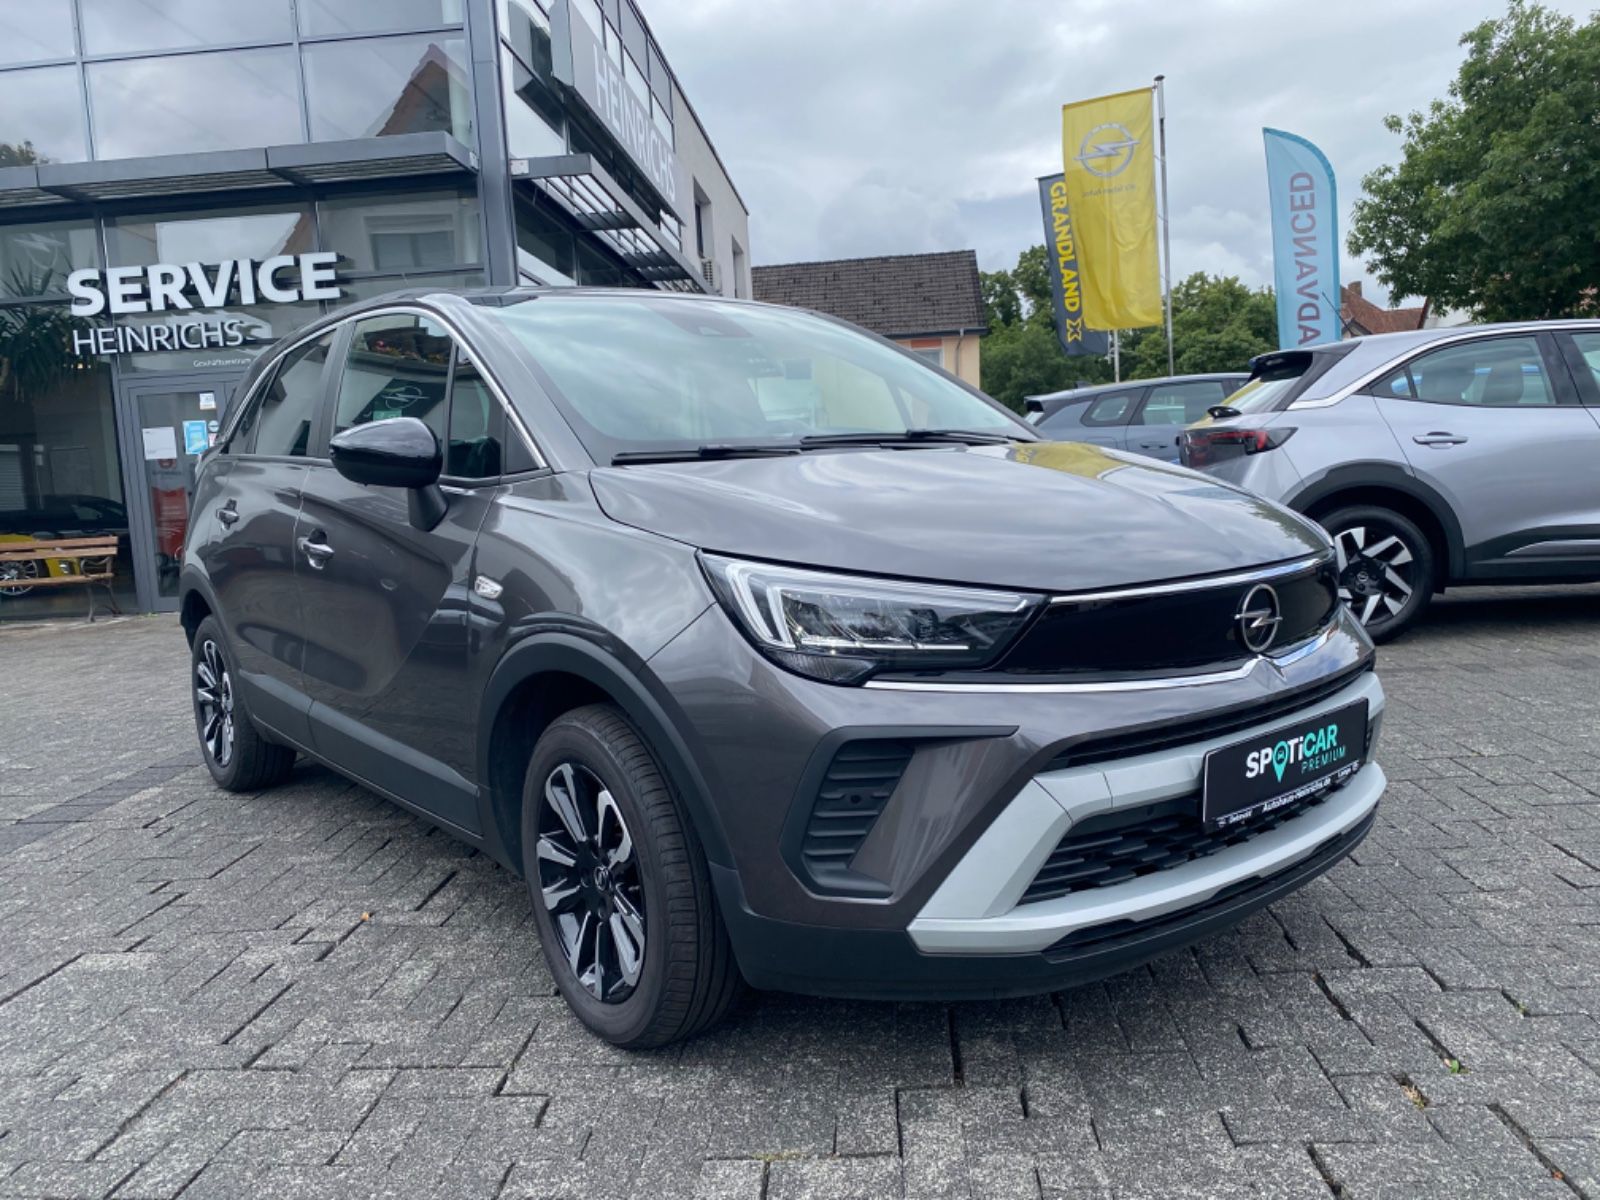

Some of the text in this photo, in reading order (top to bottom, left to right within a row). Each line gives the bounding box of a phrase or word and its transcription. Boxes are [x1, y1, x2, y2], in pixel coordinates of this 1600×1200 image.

[593, 42, 676, 203] HEINRICHS
[1050, 181, 1082, 313] GRANDLAND
[67, 251, 341, 317] SERVICE
[72, 318, 244, 356] HEINRICHS
[1301, 745, 1346, 774] PREMIUM
